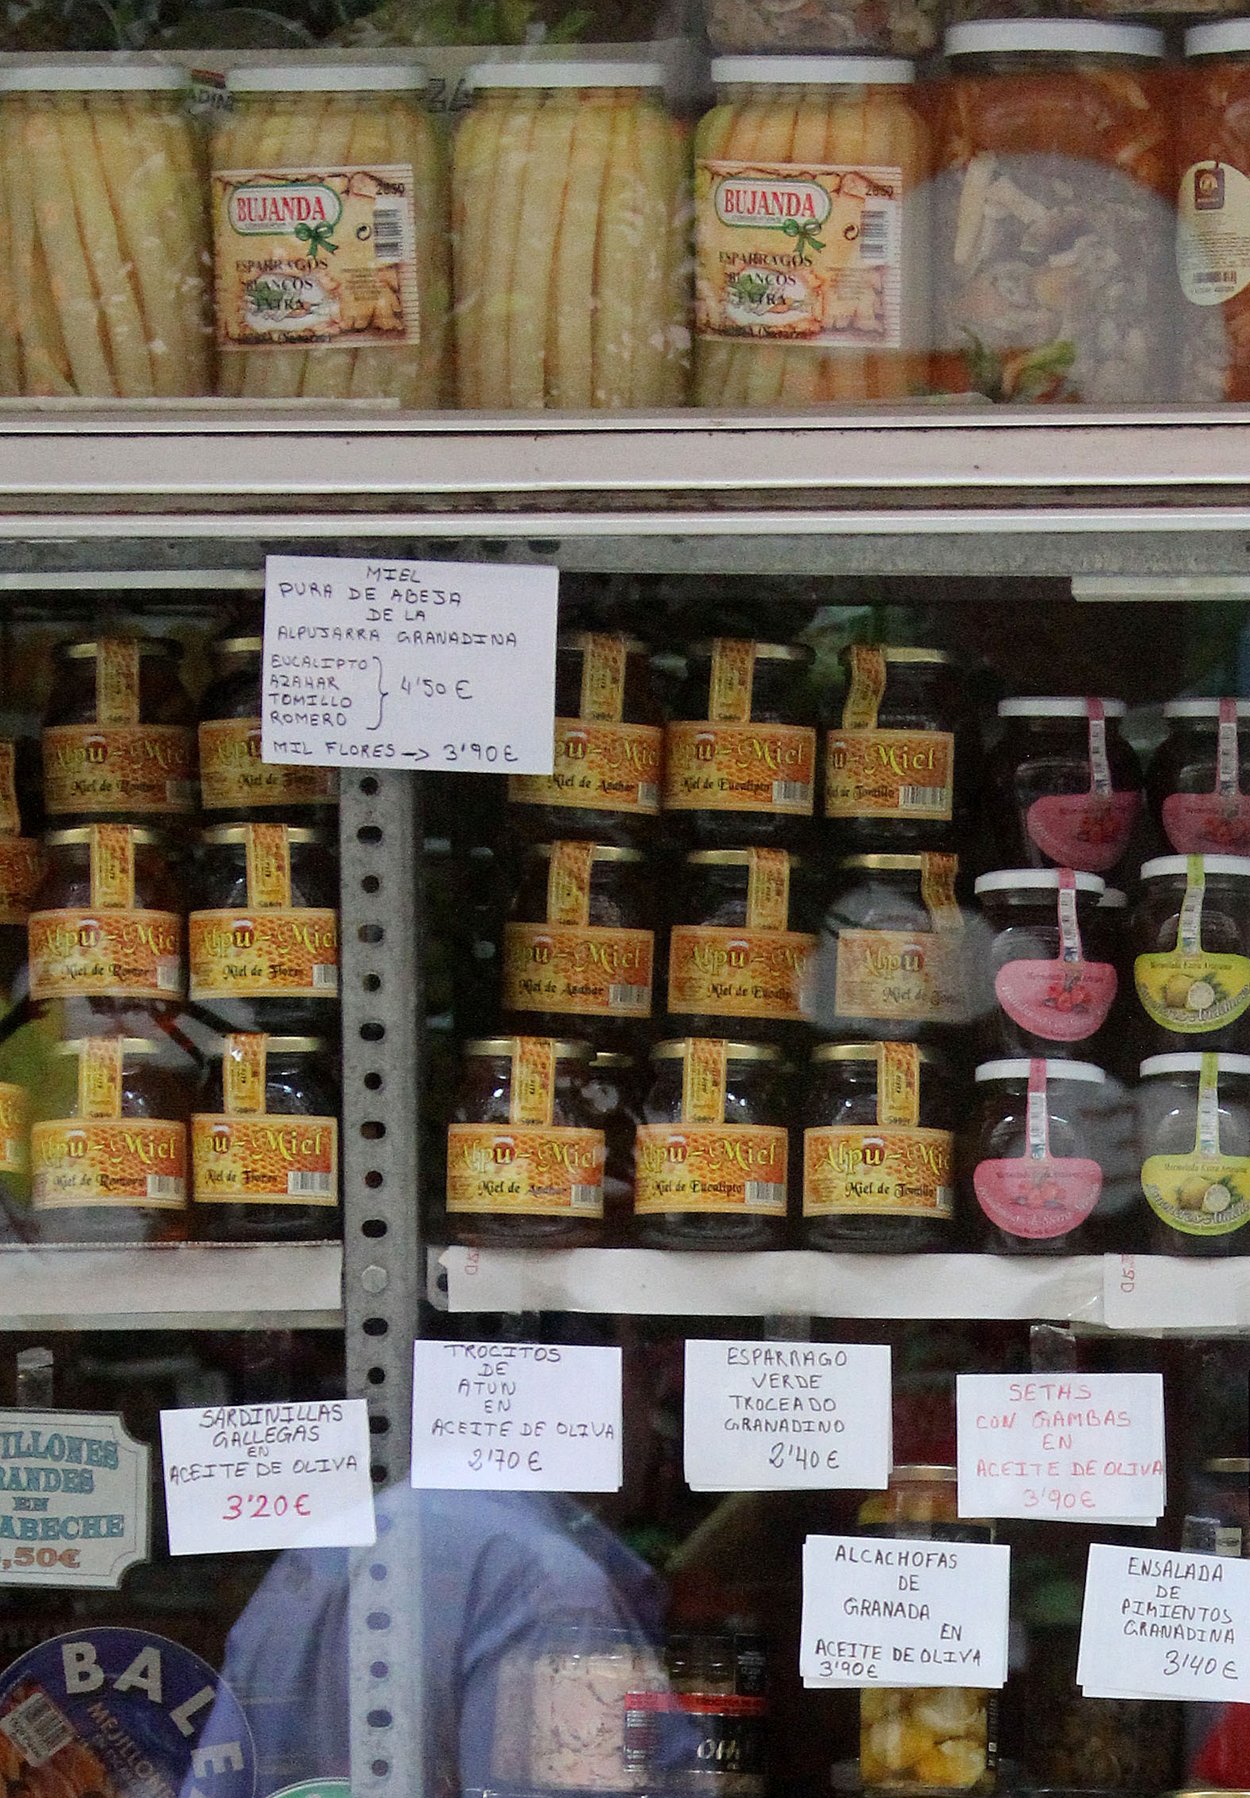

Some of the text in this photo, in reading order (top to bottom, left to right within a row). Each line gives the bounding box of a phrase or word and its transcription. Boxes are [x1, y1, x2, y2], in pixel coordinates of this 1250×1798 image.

[237, 196, 326, 222] BUJANDA
[724, 189, 816, 218] BUJANDA
[366, 566, 421, 583] MIEL
[279, 582, 461, 606] PURA ABEJA
[278, 626, 517, 646] ALPUJARRA GRANADINA
[326, 743, 395, 758] FLORES
[444, 1344, 562, 1363] TROCITOS
[458, 1379, 516, 1396] ATUN
[751, 1374, 820, 1390] VERDE
[1009, 1383, 1092, 1401] SETAS
[199, 1404, 343, 1428] SARDINILLAS
[1031, 1410, 1132, 1430] GAMBAS
[213, 1425, 320, 1447] GALLEGAS
[431, 1420, 512, 1438] ACEITE
[170, 1455, 358, 1484] ACEITE OLIVA
[976, 1459, 1059, 1478] ACEITE
[835, 1544, 958, 1570] ALCACHOFAS
[1128, 1557, 1225, 1582] ENSALADA
[843, 1598, 931, 1621] GRANADA
[1121, 1598, 1233, 1624] PIMIENTOS
[1123, 1620, 1236, 1644] GRANADINA
[815, 1639, 882, 1661] ACEITE
